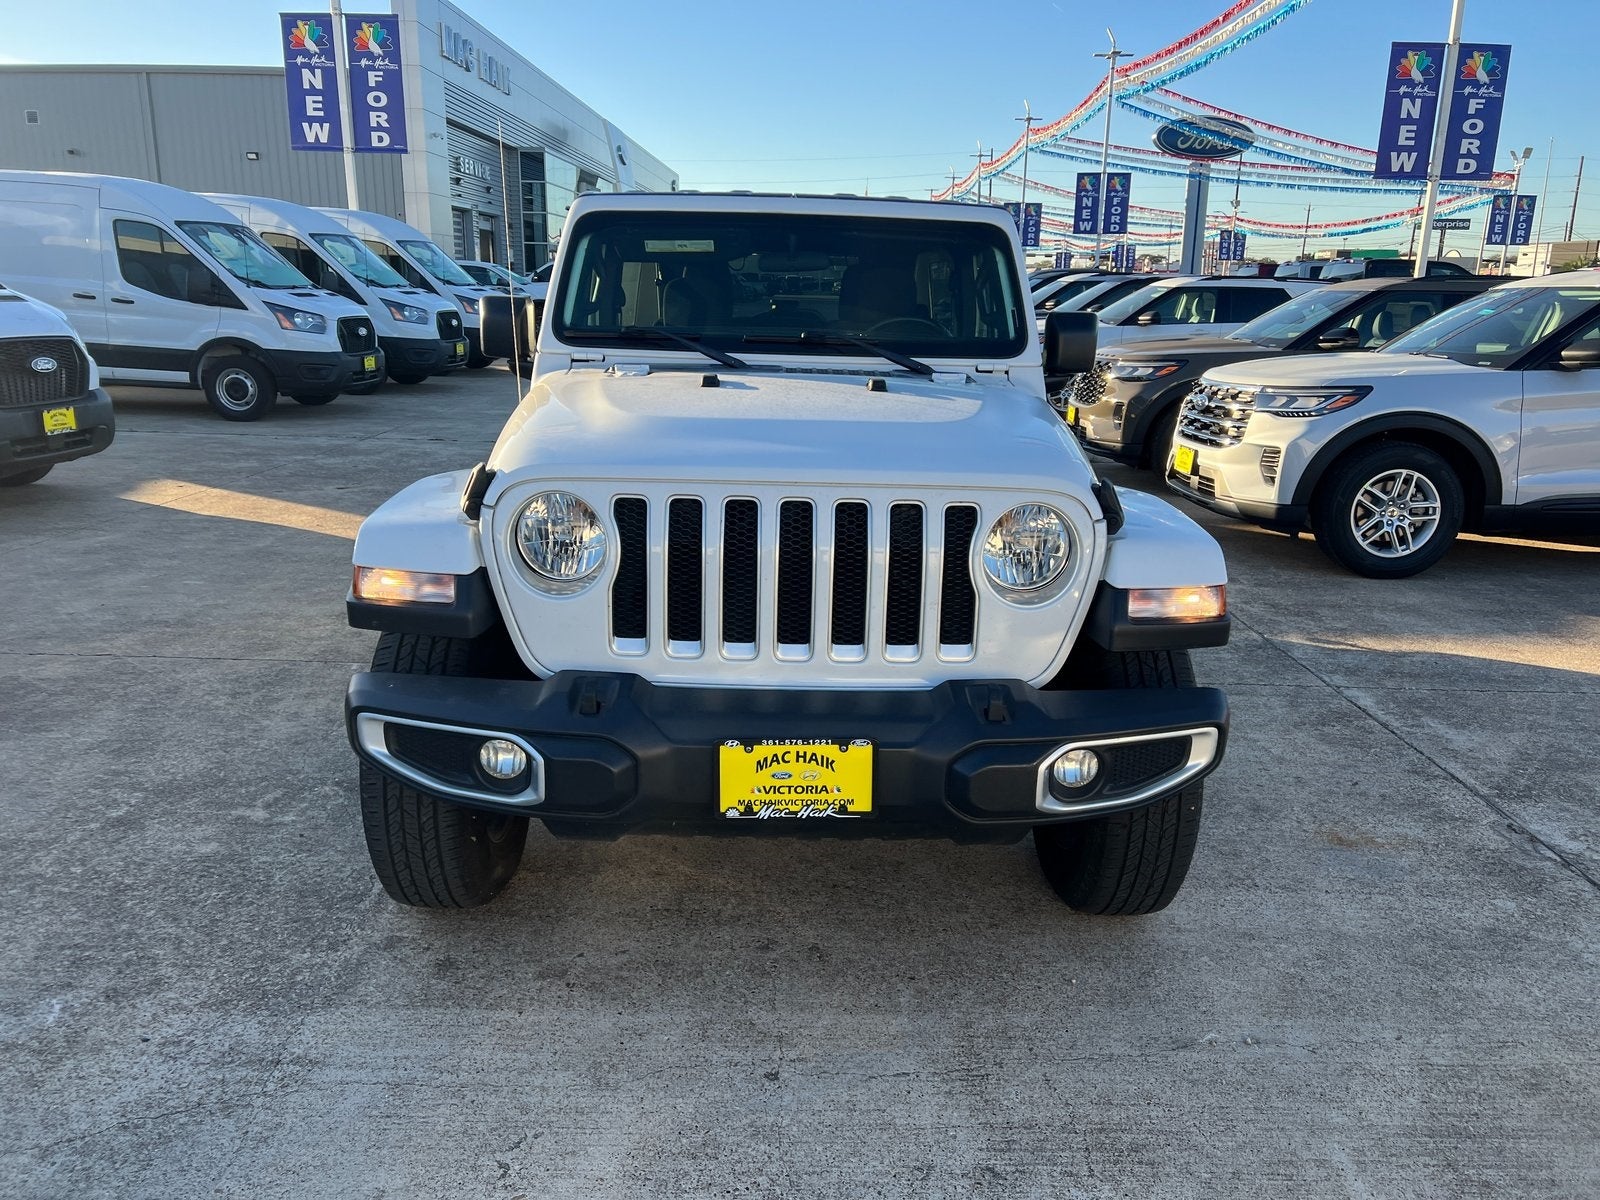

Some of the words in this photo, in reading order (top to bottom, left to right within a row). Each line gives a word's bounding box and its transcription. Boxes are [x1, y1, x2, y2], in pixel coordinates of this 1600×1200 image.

[301, 68, 330, 143] NEW
[366, 71, 391, 147] FORD
[1390, 98, 1422, 172] NEW
[1456, 98, 1486, 174] FORD
[460, 156, 491, 180] SERVICE
[1079, 197, 1093, 231] NEW
[1110, 197, 1122, 232] FORD
[1433, 220, 1470, 230] terprise
[1491, 214, 1505, 243] NEW
[1027, 220, 1036, 245] FORD
[1515, 215, 1528, 244] FORD
[755, 751, 791, 773] MAC
[795, 750, 836, 773] HAIK
[762, 785, 830, 795] VICTORIA
[755, 804, 796, 820] Mac
[796, 804, 843, 819] Haik
